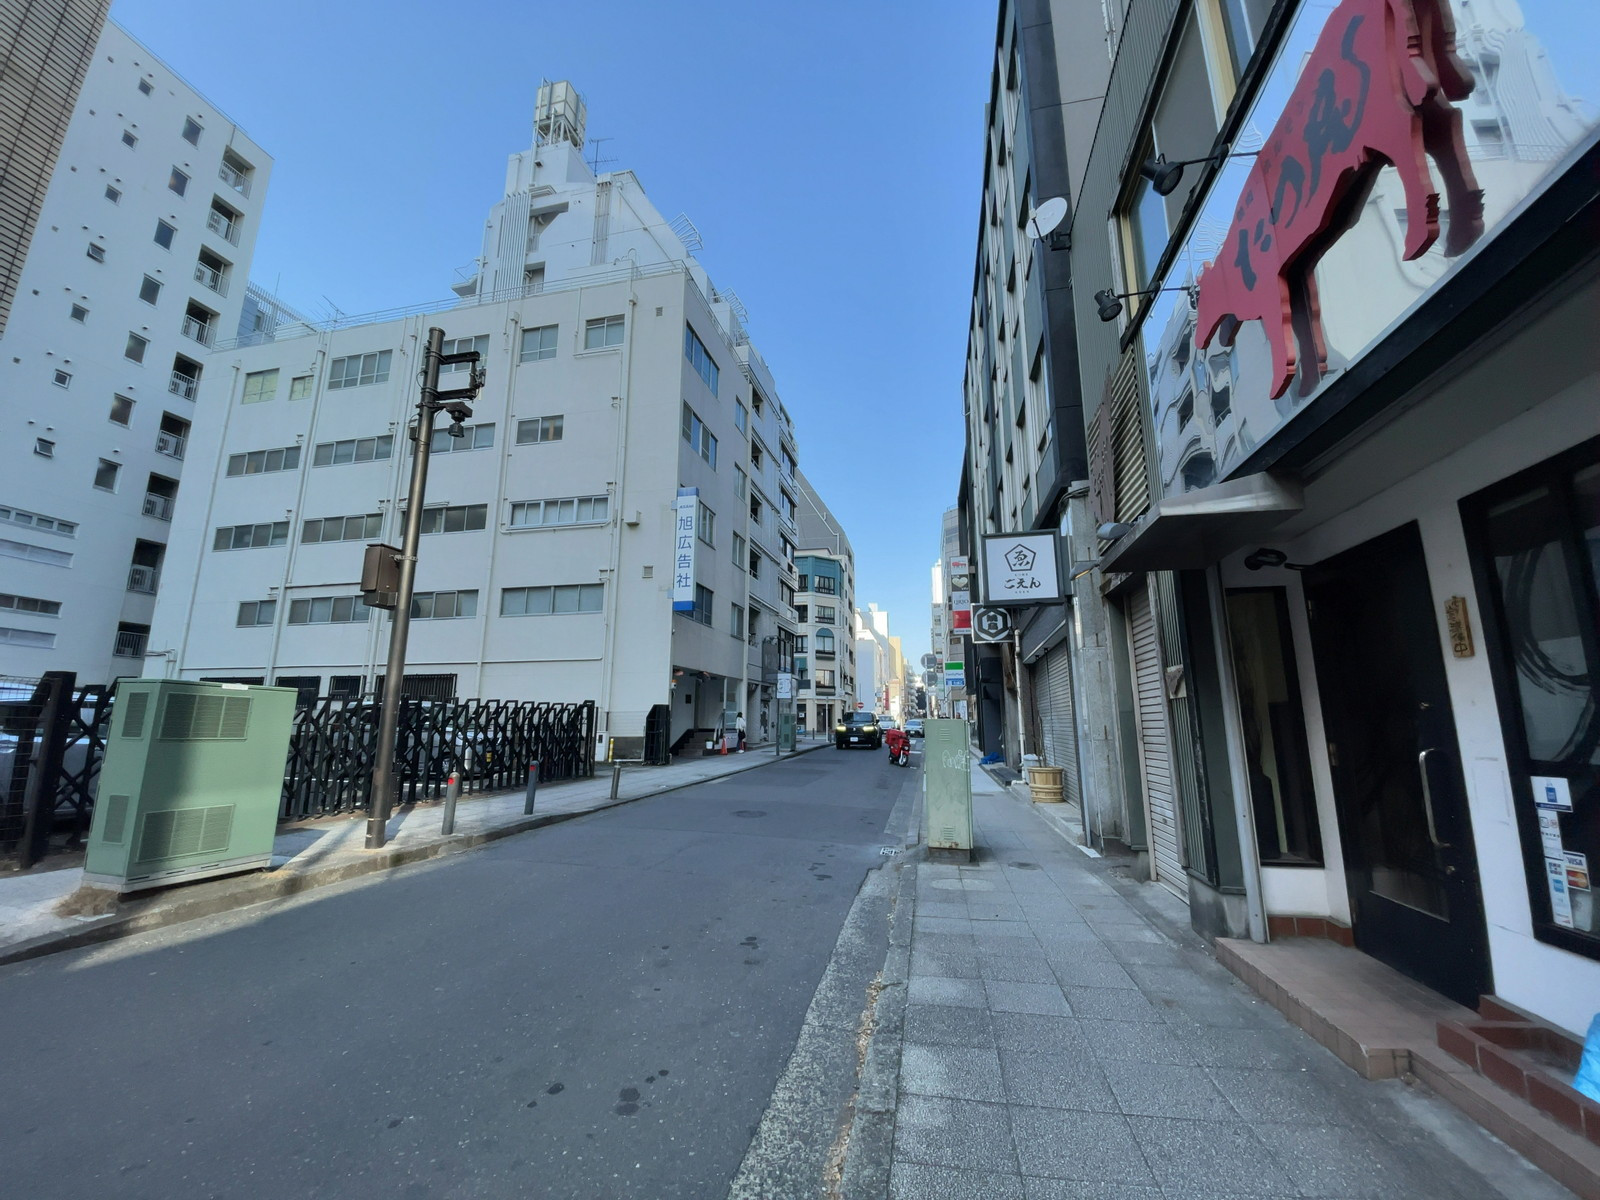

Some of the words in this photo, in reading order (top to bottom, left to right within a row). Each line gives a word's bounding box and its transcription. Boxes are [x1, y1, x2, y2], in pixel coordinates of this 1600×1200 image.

[676, 515, 693, 589] 旭広告社
[1566, 856, 1583, 866] VISA
